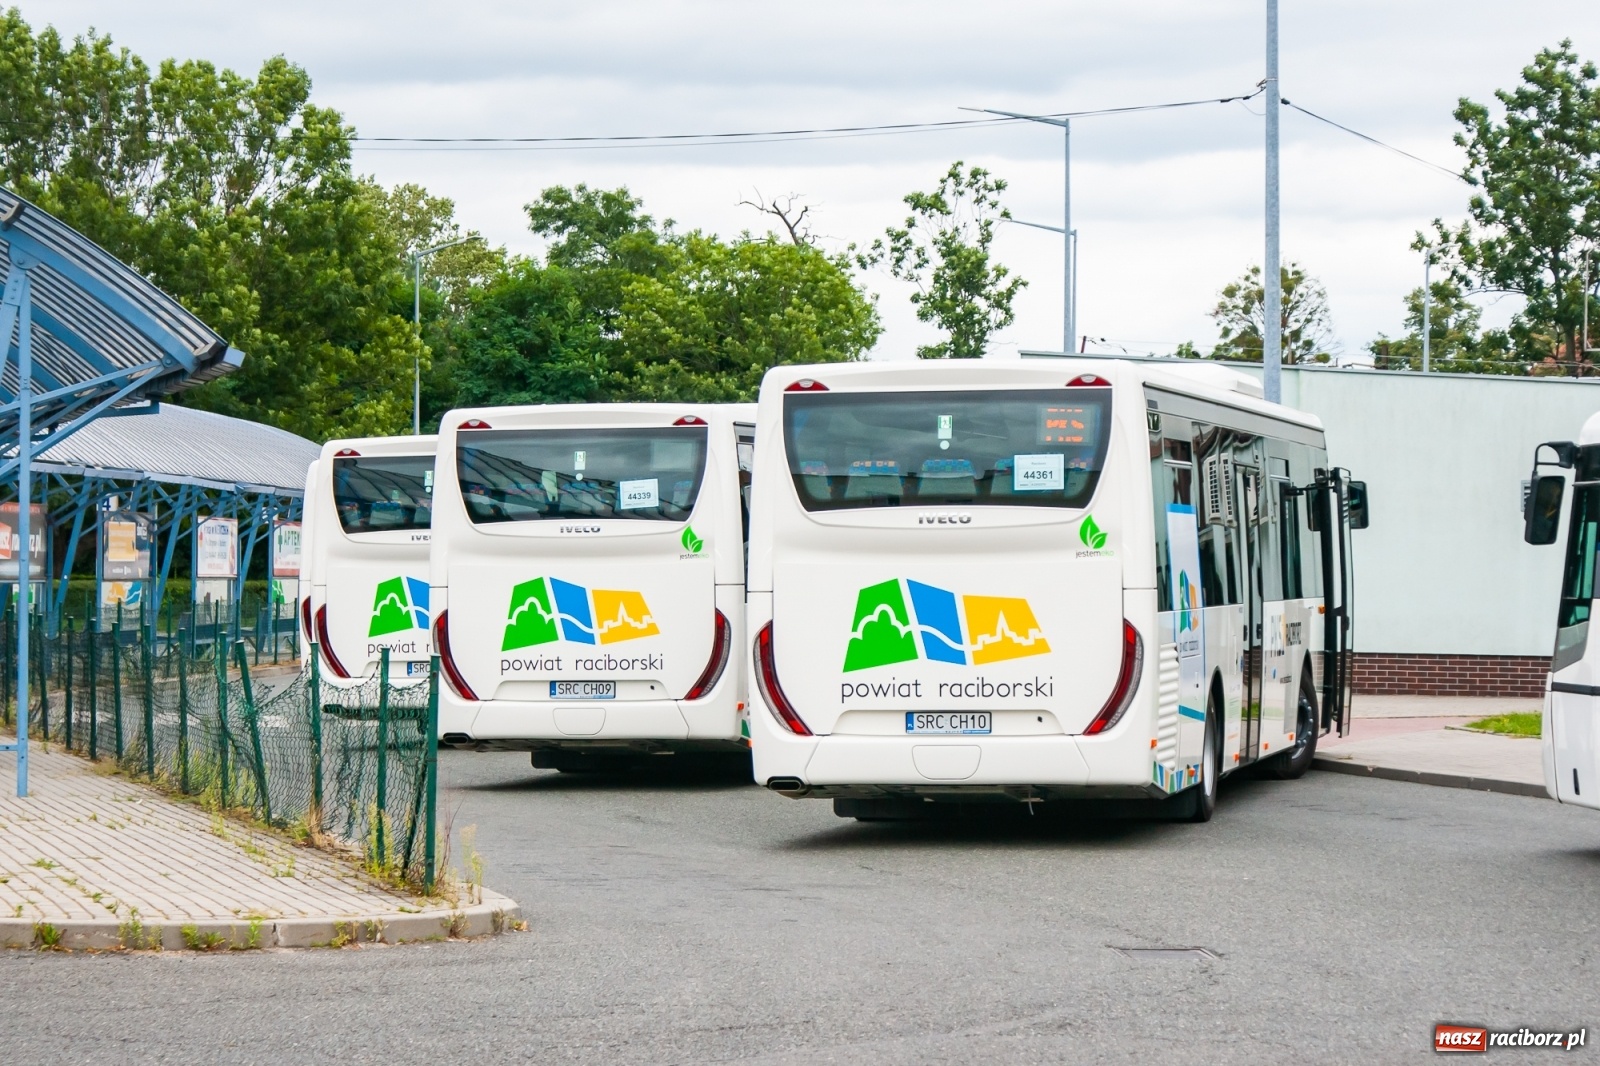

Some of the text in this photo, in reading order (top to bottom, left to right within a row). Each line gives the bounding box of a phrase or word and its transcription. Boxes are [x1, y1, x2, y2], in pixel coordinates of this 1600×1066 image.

[1024, 470, 1053, 480] 44361
[627, 491, 652, 500] 44339
[918, 512, 972, 525] IVECO
[559, 524, 601, 533] IVECO
[500, 653, 664, 676] powiat raciborski
[558, 683, 612, 695] SRC CH09
[841, 676, 1054, 704] powiat raciborski
[916, 714, 986, 729] SRC CH10
